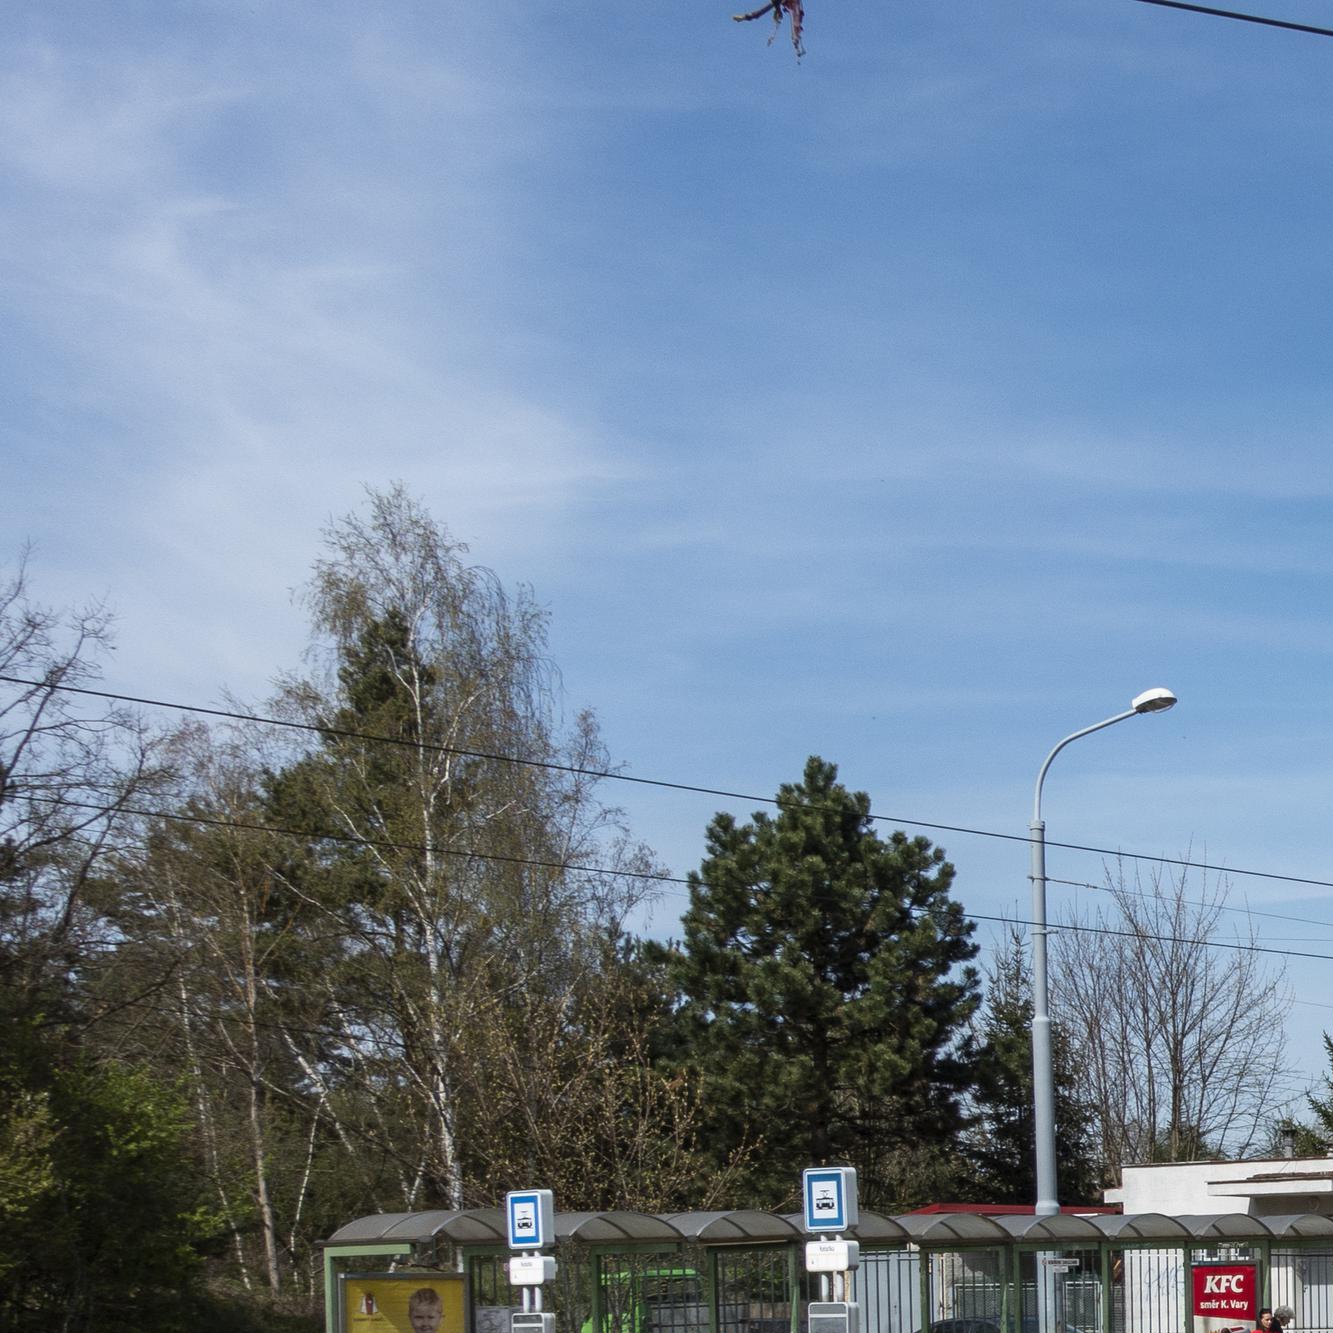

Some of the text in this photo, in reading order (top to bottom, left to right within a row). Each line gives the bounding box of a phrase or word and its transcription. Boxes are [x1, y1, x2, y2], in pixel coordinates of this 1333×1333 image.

[1204, 1275, 1244, 1293] KFC
[1200, 1300, 1248, 1310] směr K. Vary
